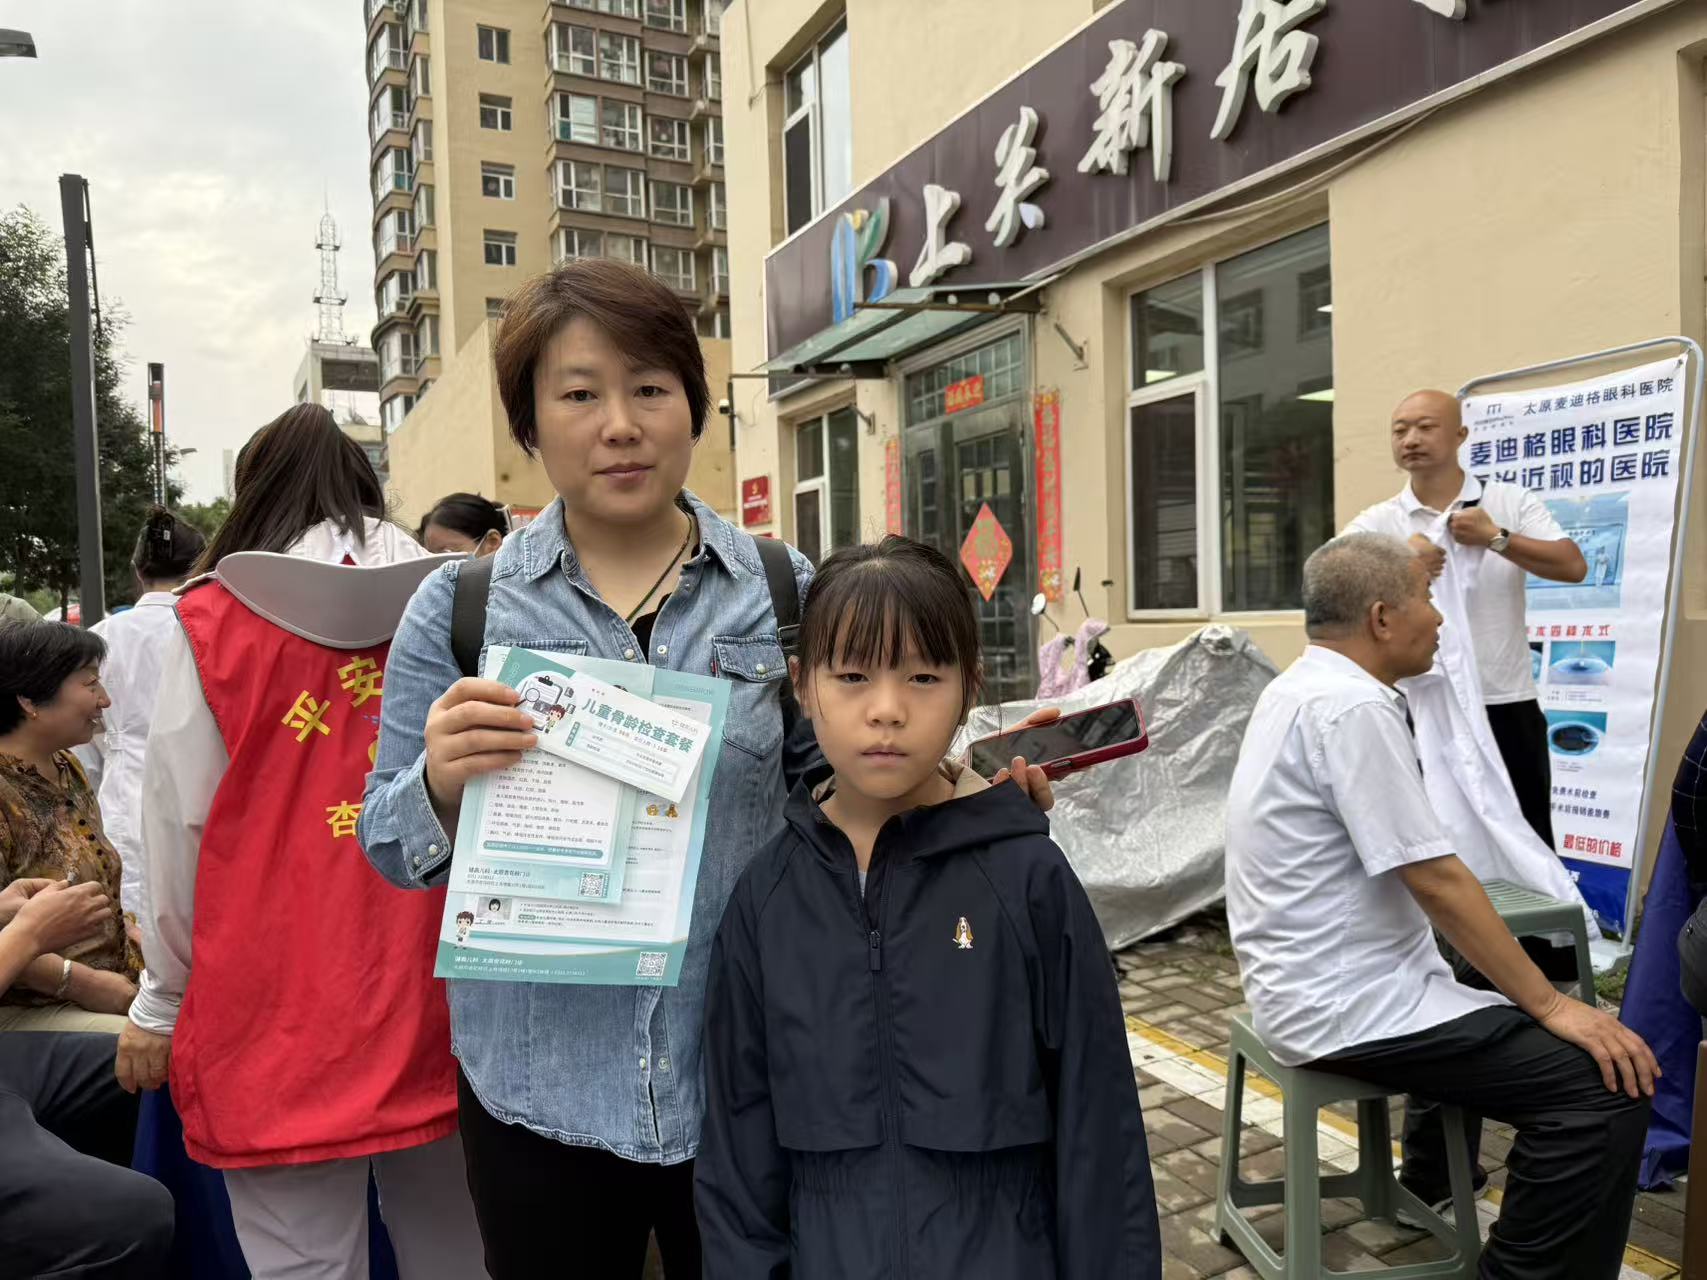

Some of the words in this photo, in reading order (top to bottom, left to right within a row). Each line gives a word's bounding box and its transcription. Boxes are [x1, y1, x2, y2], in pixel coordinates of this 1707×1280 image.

[909, 0, 1467, 287] 上关新居
[1523, 377, 1674, 416] 太原麦迪格眼科医院
[1470, 412, 1675, 467] 麦迪格眼科医院
[1473, 449, 1671, 491] 治近视的医院
[581, 698, 694, 753] 儿童骨龄检查套餐
[1563, 833, 1622, 858] 最低的价格
